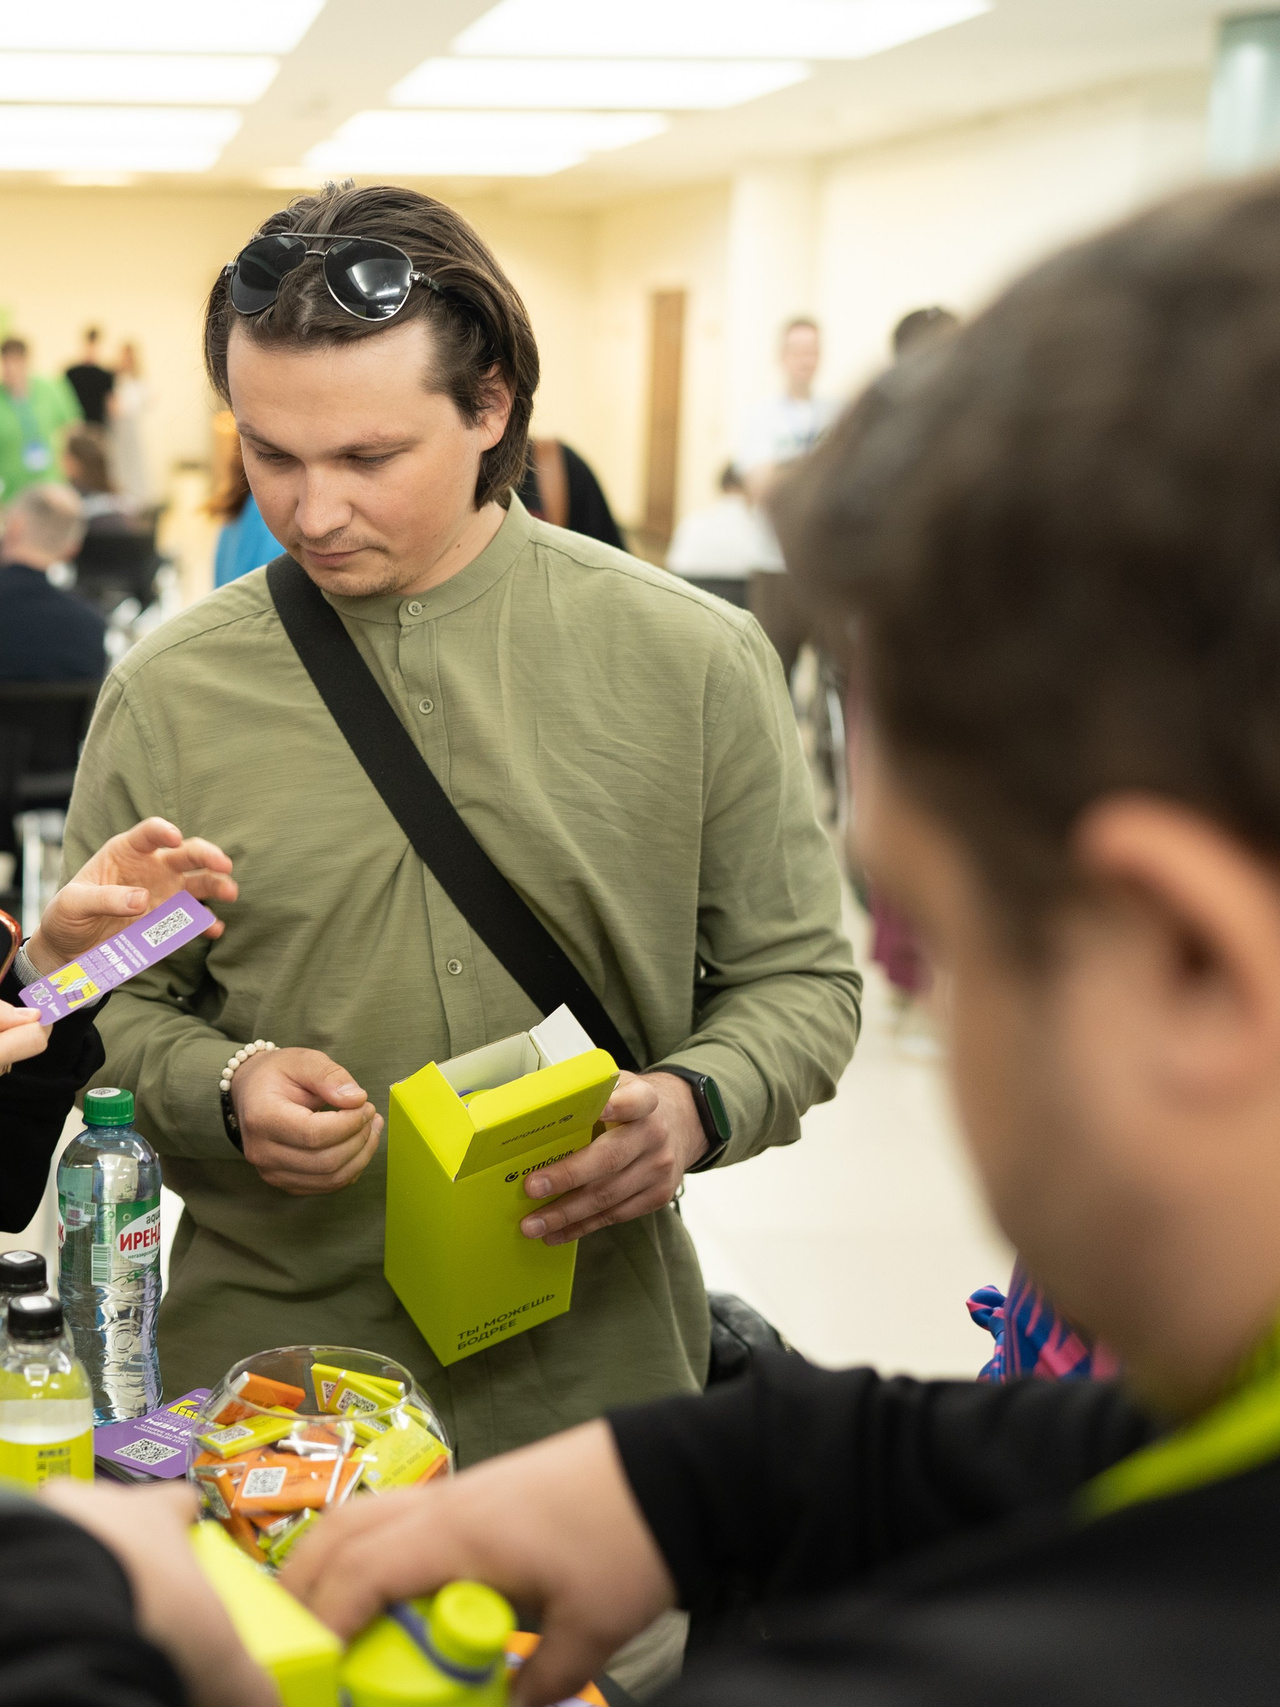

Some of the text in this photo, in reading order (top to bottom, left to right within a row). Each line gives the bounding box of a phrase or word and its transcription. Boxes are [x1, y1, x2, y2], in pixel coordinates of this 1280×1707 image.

[98, 943, 122, 965] КРУТОЙ
[114, 960, 132, 977] МЕРЧ
[457, 1293, 555, 1340] ТЫ МОЖЕШЬ
[457, 1318, 517, 1351] БОДРЕЕ
[144, 1417, 180, 1432] МЕРЧ
